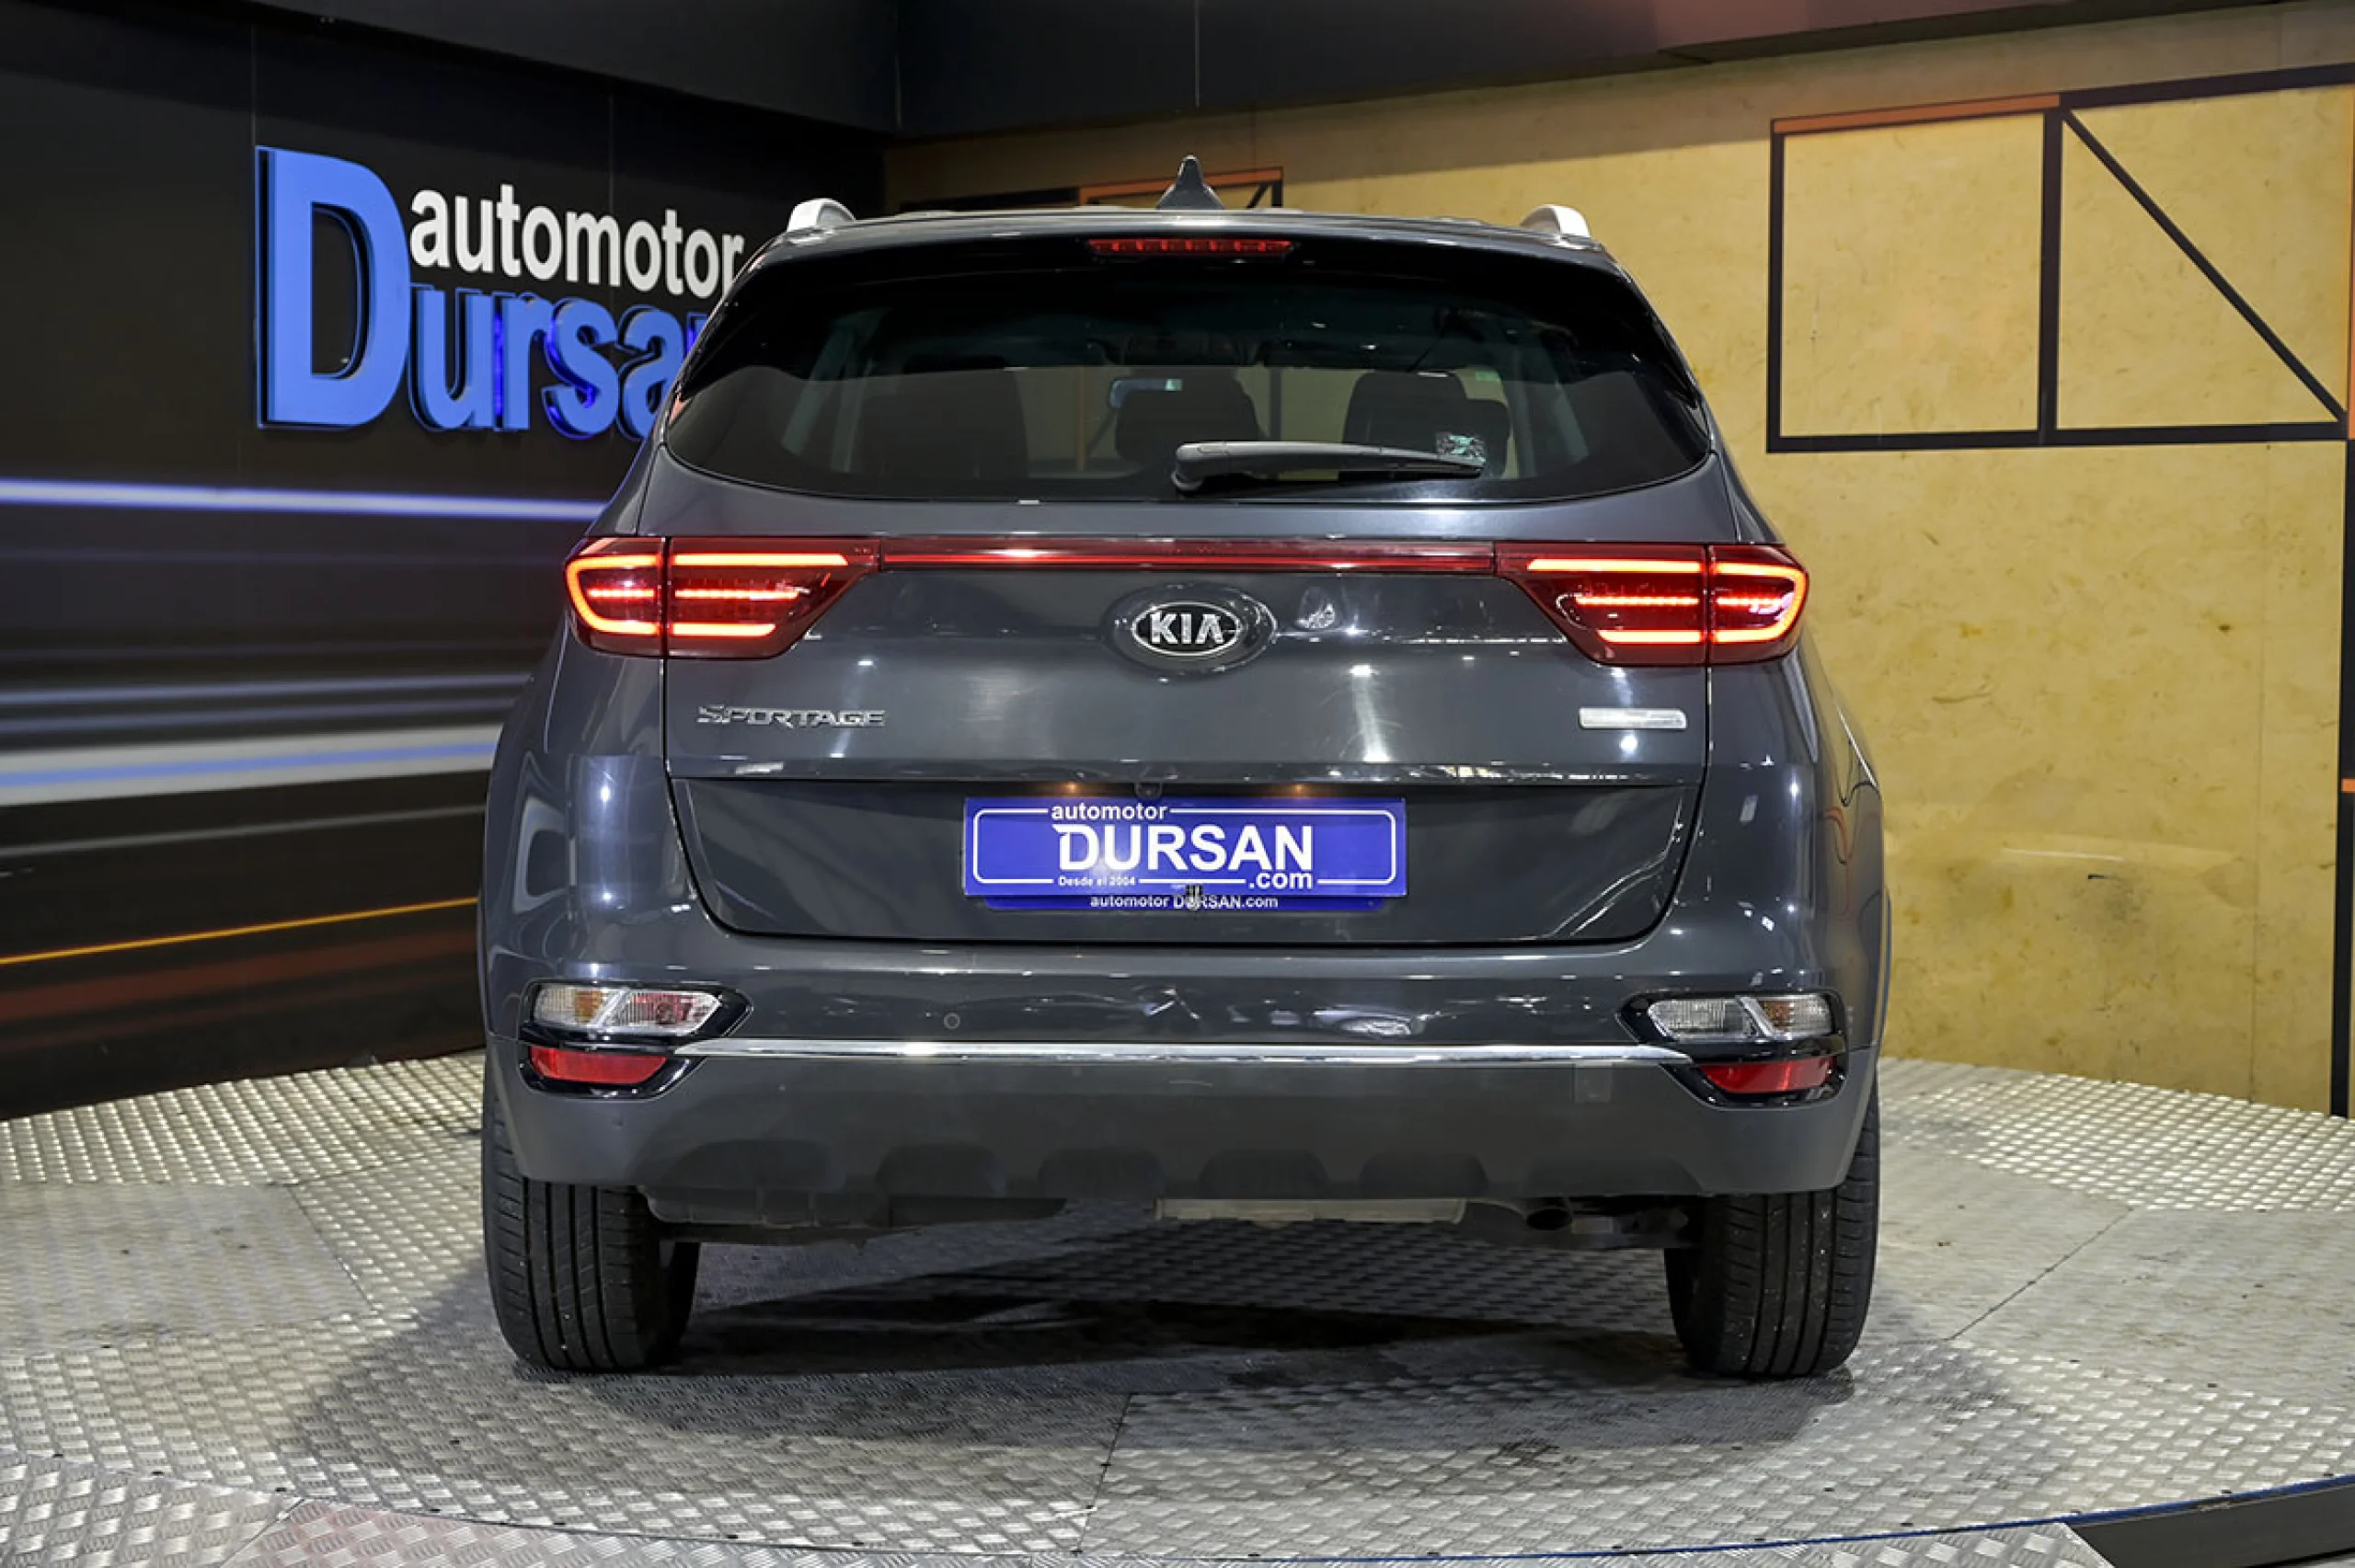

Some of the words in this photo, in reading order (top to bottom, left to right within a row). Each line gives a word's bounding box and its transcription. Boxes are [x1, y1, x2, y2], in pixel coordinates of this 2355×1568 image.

[409, 183, 743, 300] automotor
[255, 144, 708, 441] Dursa
[1150, 612, 1223, 644] KIA
[696, 704, 885, 728] SPORTAGE
[1051, 803, 1167, 820] automotor
[1051, 824, 1313, 871] DURSAN
[1248, 872, 1313, 889] .com
[1090, 896, 1170, 908] automotor
